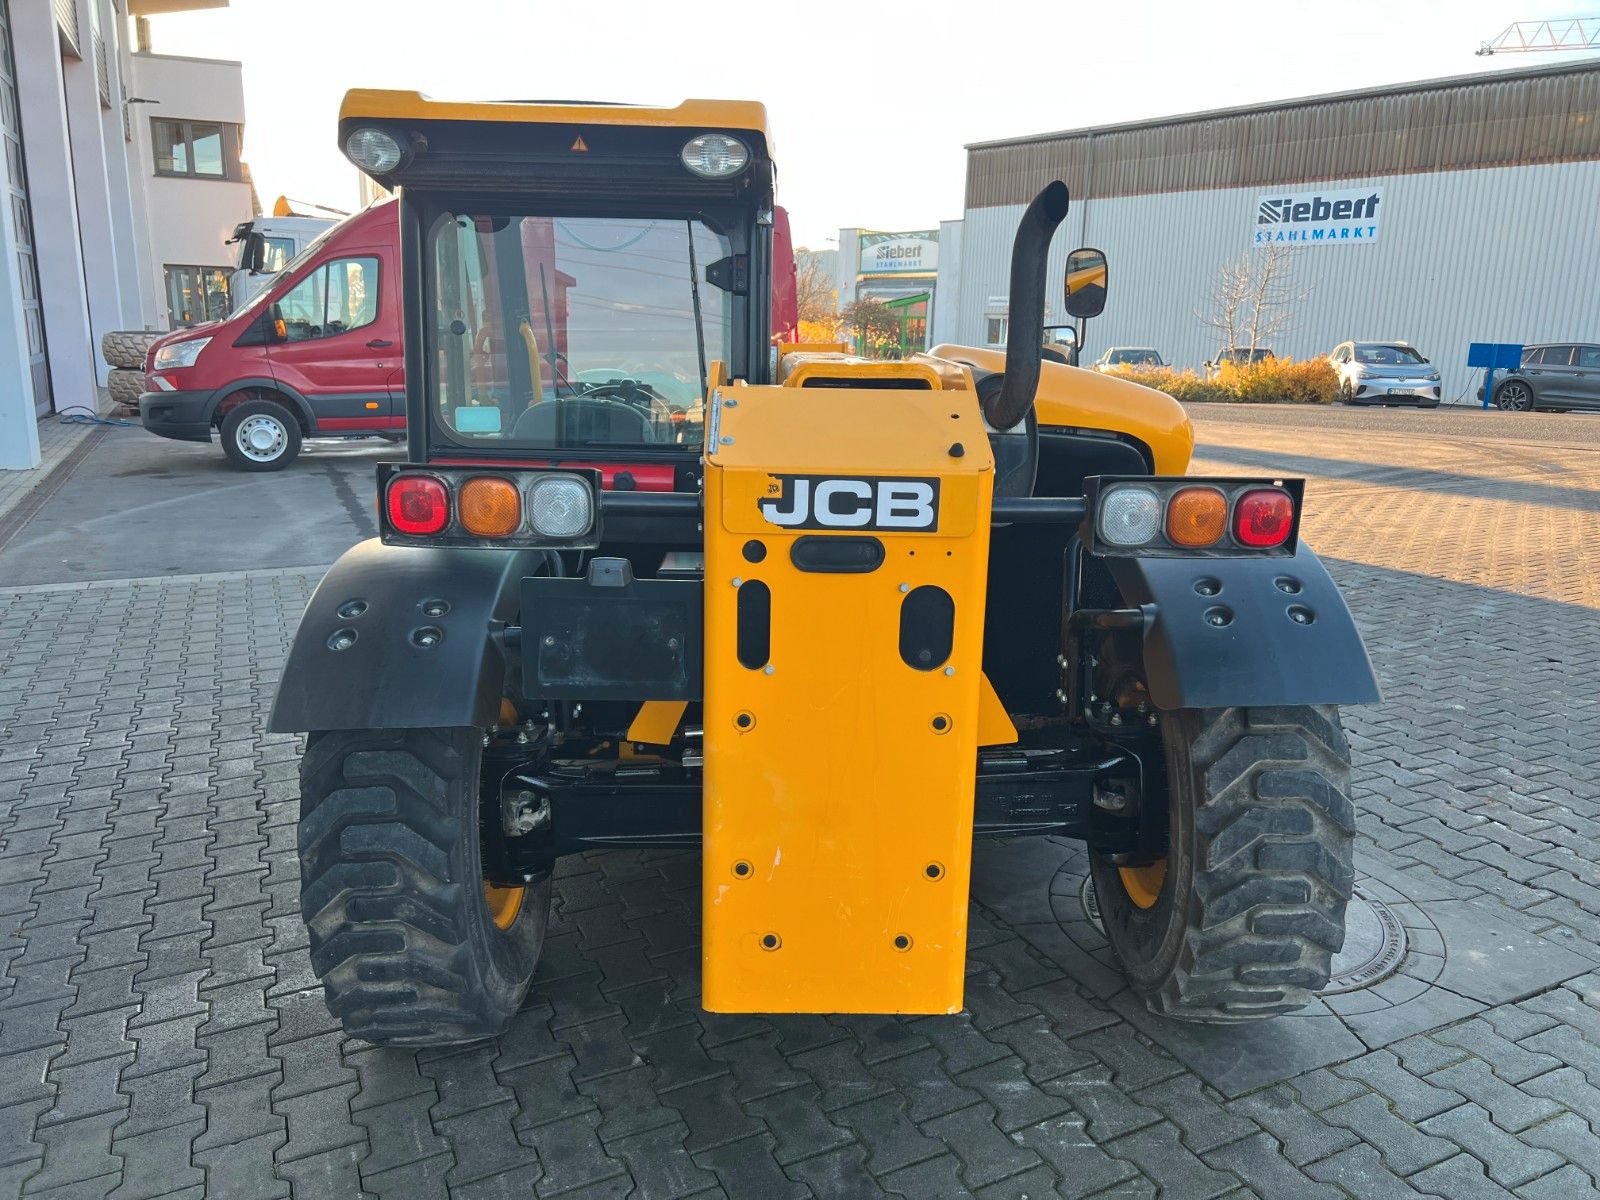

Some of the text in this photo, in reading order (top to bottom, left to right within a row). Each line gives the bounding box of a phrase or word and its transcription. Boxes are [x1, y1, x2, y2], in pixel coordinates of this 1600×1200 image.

[1258, 193, 1380, 225] Siebert
[1256, 226, 1376, 242] STAHLMARKT
[876, 245, 922, 259] Siebert
[762, 479, 934, 528] JCB
